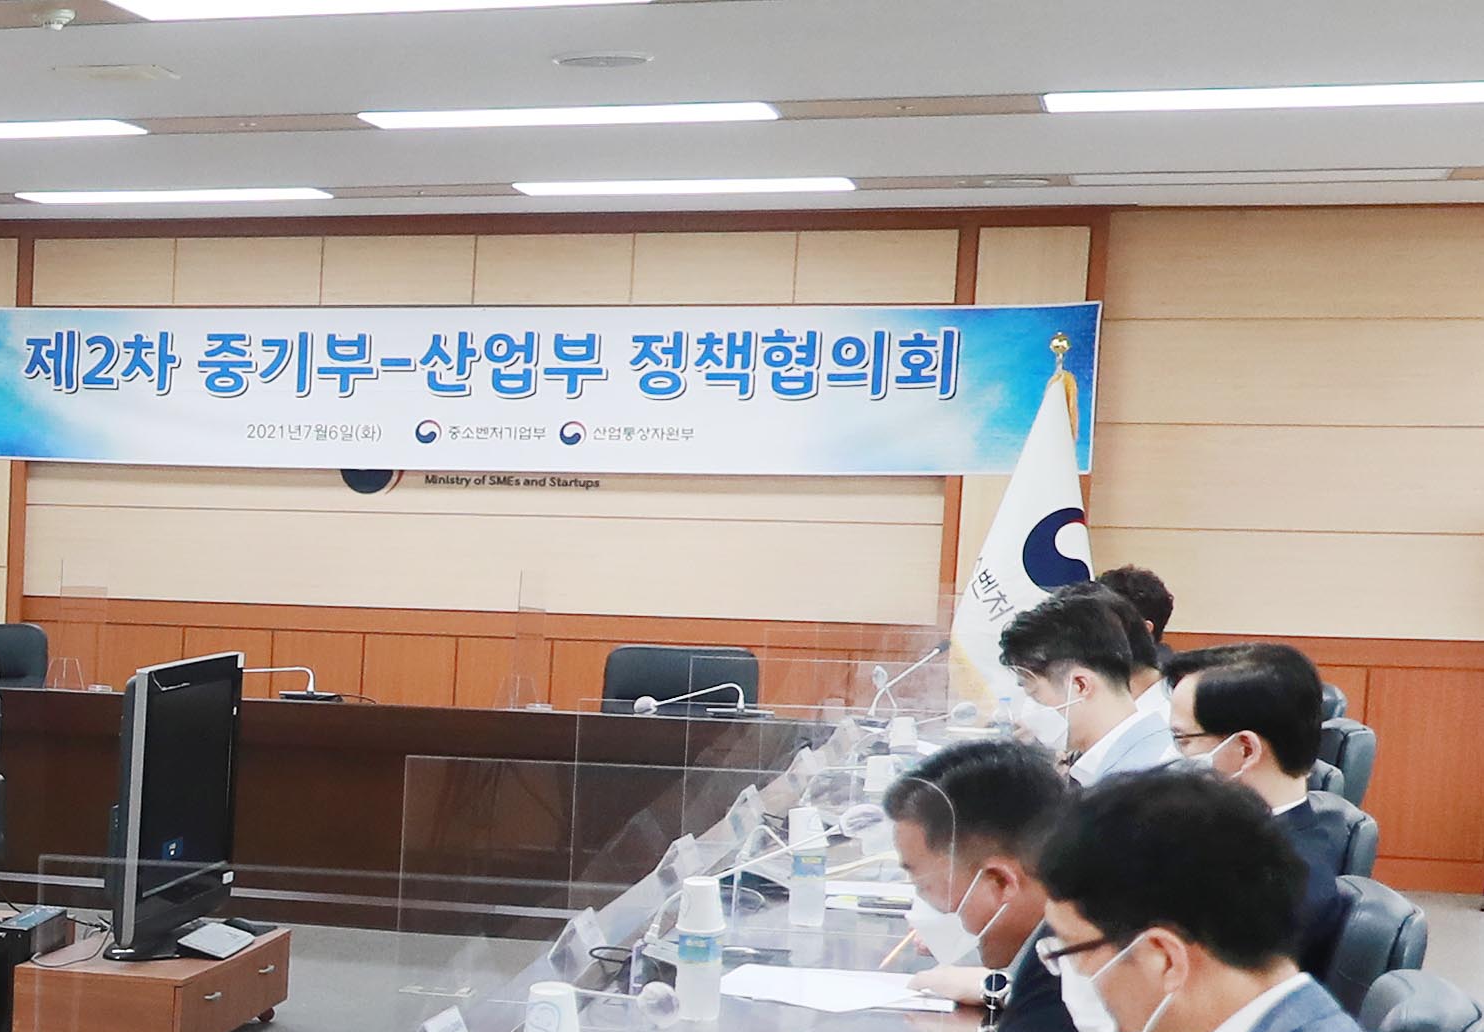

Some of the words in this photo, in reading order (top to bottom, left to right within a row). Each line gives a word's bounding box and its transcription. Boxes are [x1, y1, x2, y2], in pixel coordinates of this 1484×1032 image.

[24, 328, 180, 394] 제2차
[196, 330, 608, 398] 중기부-산업부
[629, 327, 963, 400] 정책협의회
[246, 422, 383, 443] 2021년7월6일(화)
[592, 425, 695, 442] 산업통상자원부
[424, 473, 471, 489] Ministry
[473, 474, 486, 487] of
[488, 475, 521, 487] SMEs
[522, 476, 547, 488] and
[548, 476, 601, 490] Startups
